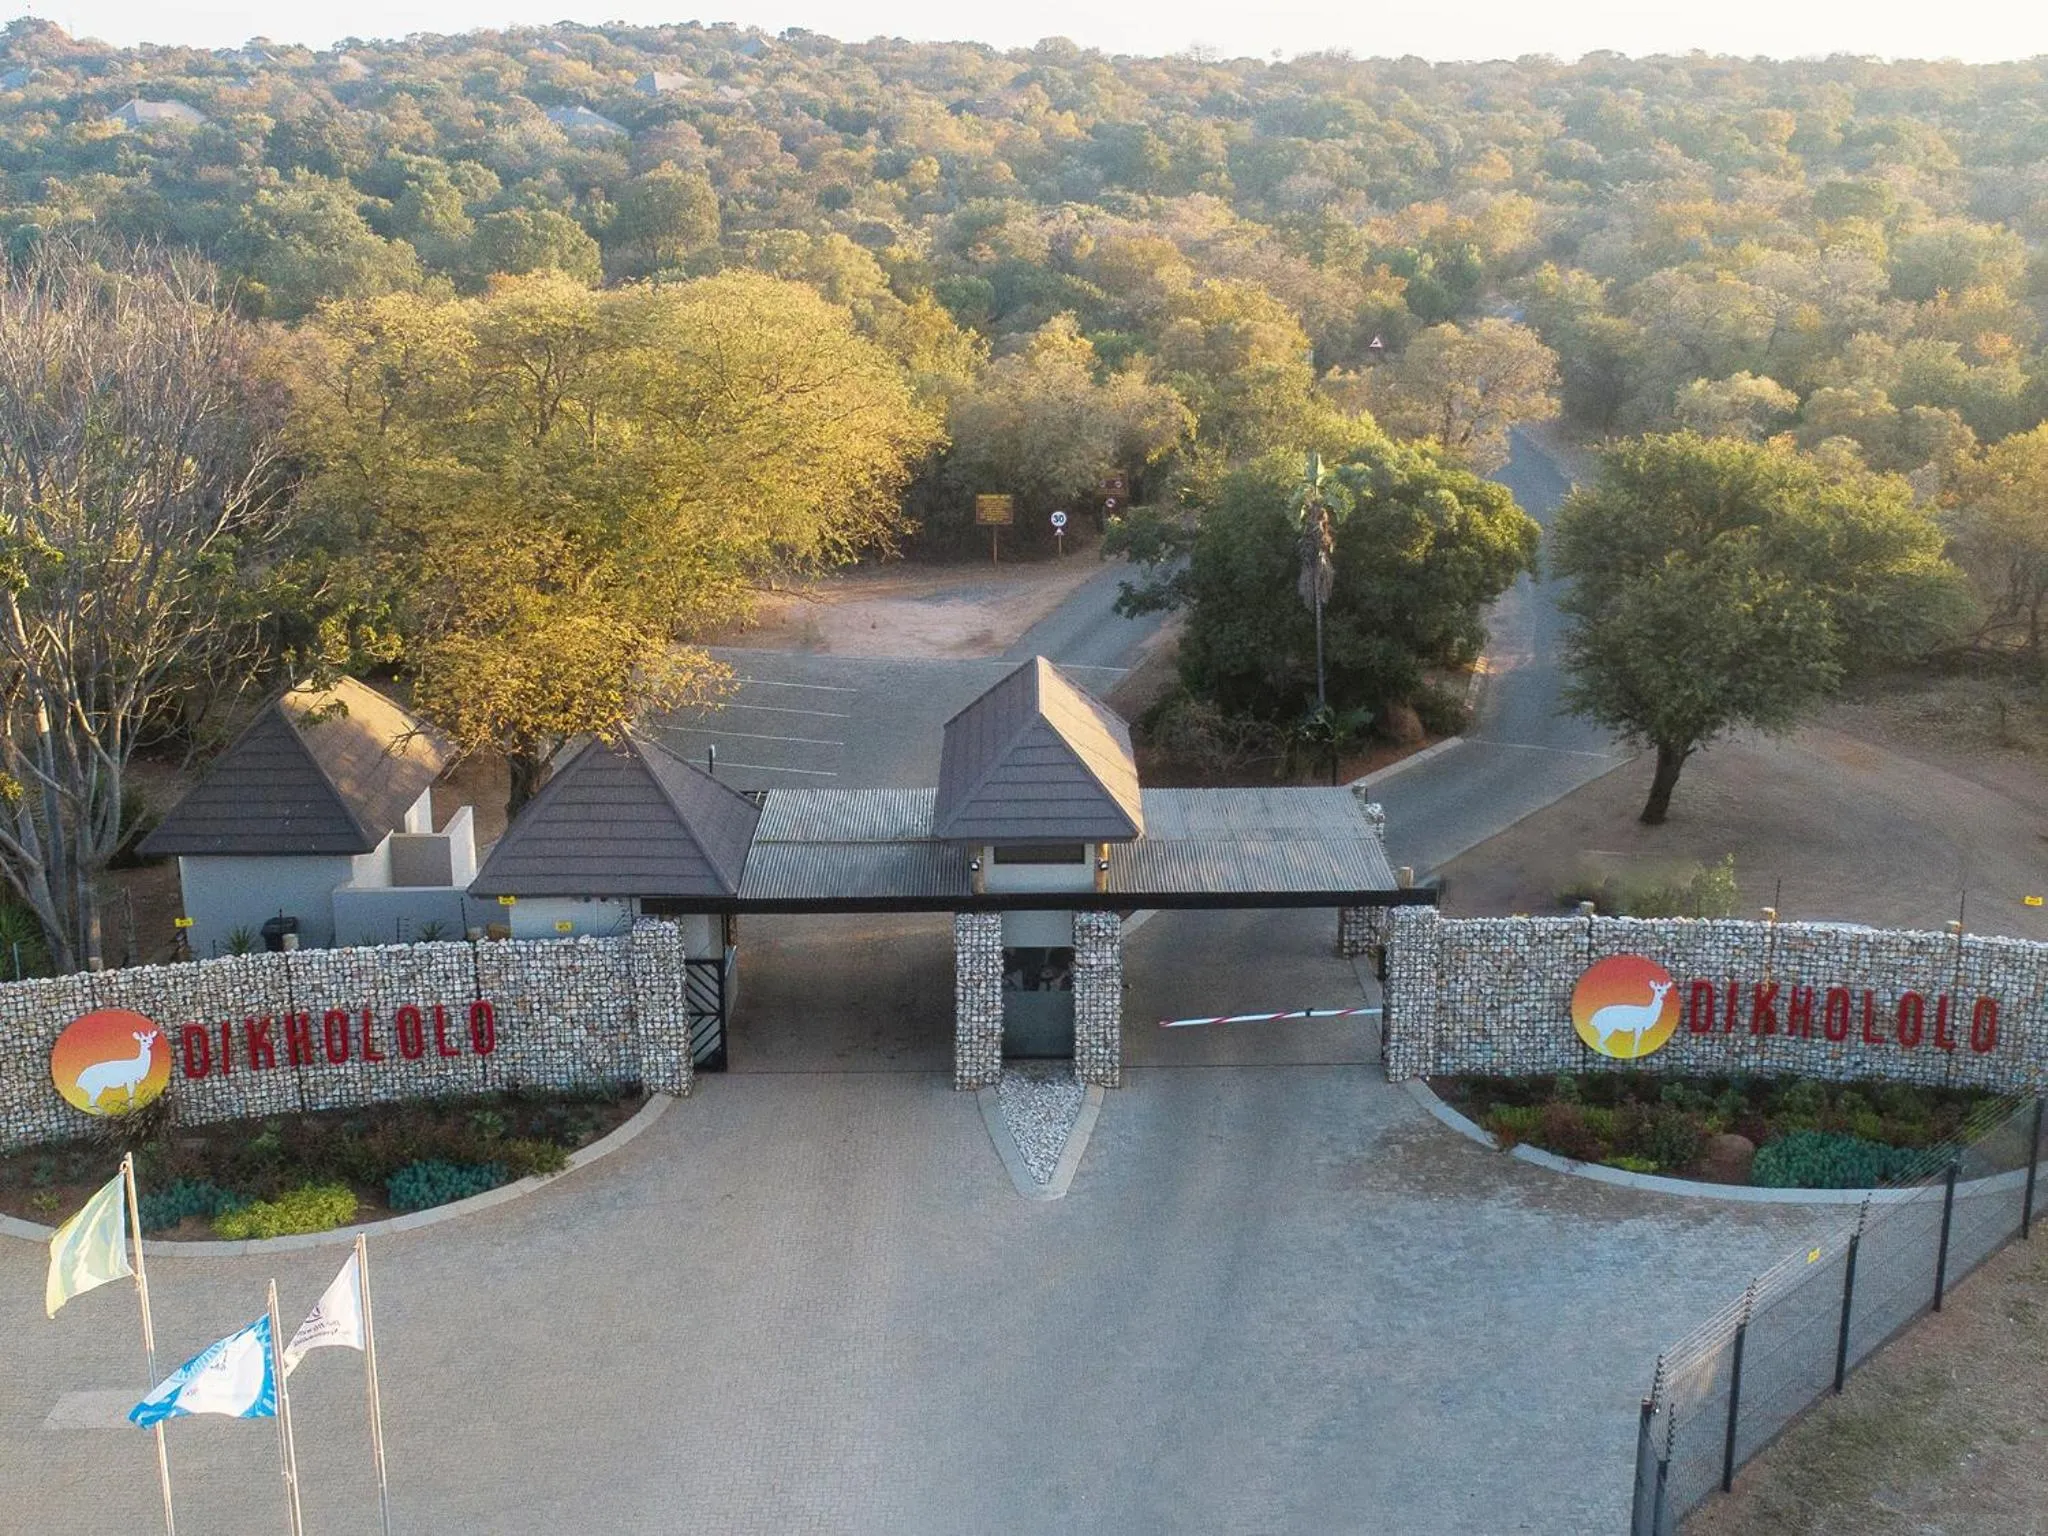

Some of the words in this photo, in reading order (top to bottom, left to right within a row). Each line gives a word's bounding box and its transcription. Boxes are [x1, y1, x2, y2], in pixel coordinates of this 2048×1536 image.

[1053, 514, 1065, 523] 30
[182, 1000, 496, 1079] DIKHOLOLO
[1689, 979, 1998, 1053] DIKHOLOLO
